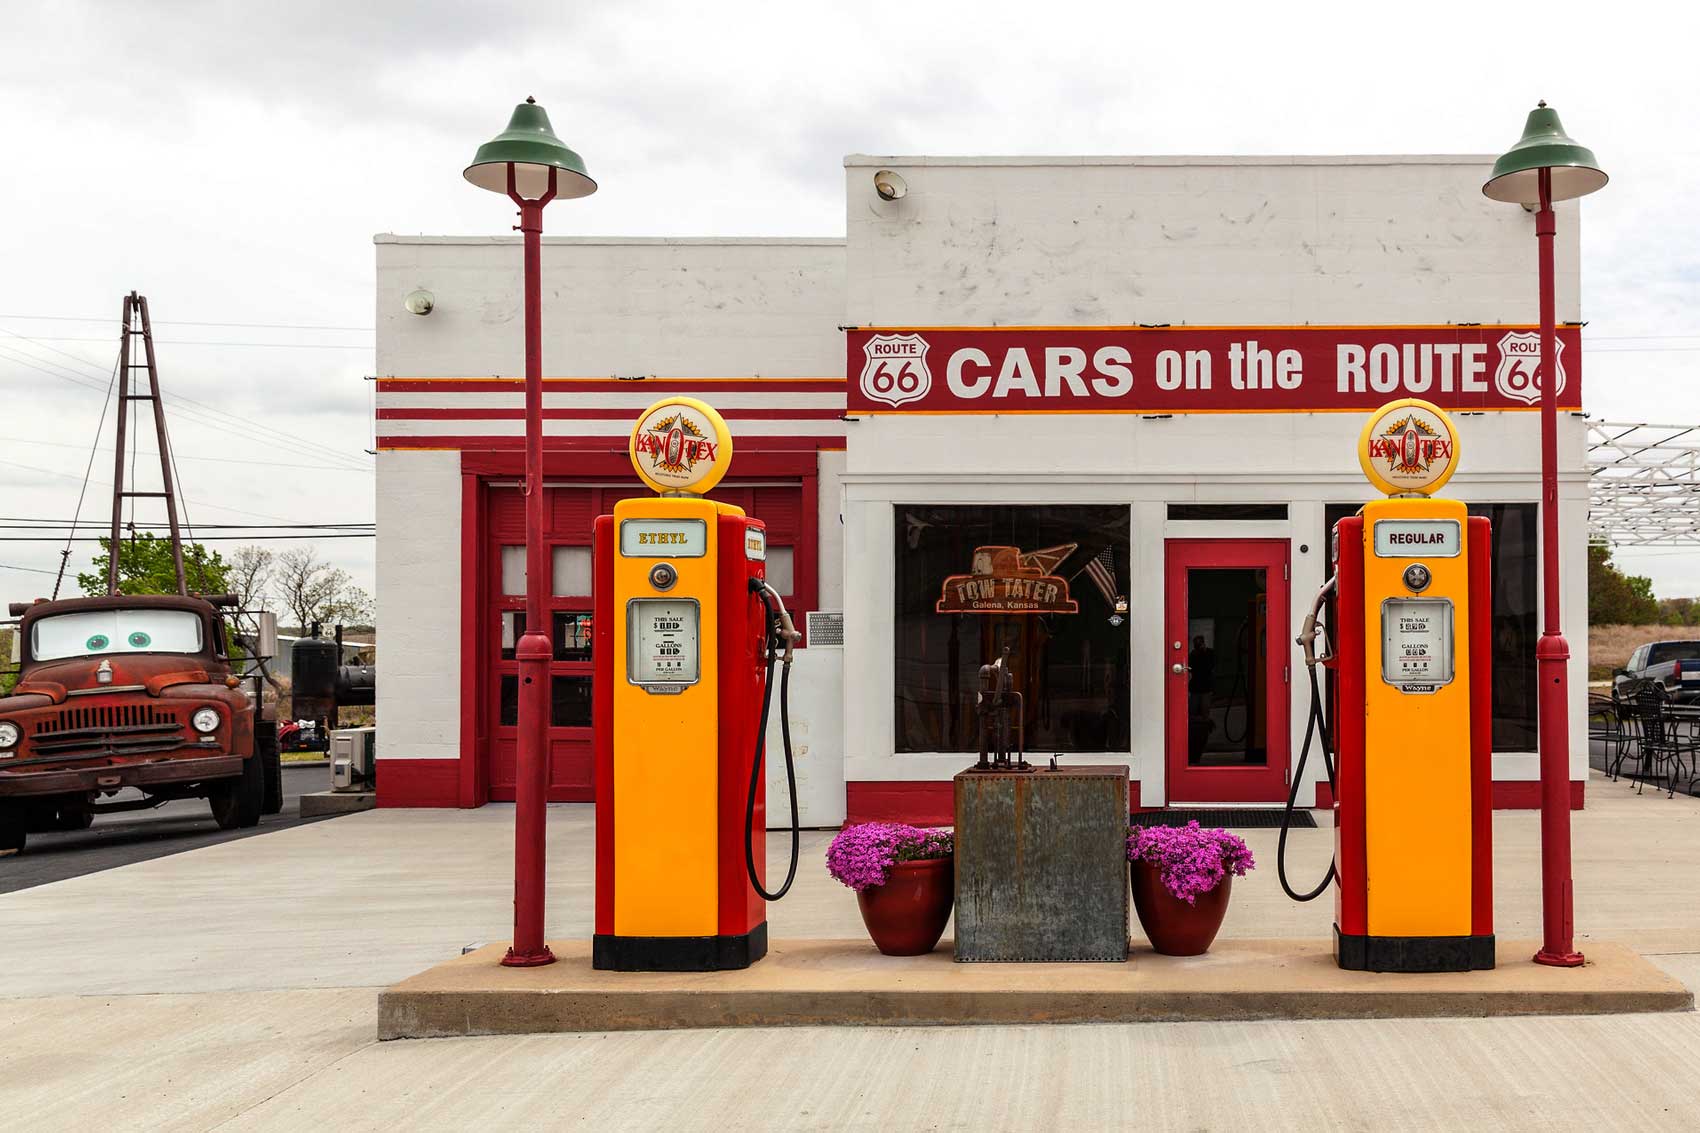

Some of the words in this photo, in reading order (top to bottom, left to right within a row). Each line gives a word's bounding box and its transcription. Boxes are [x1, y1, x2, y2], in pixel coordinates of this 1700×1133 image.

[874, 343, 917, 355] ROUTE
[1510, 343, 1541, 353] ROU
[946, 346, 1134, 399] CARS
[1155, 349, 1212, 391] on
[1228, 340, 1303, 391] the
[1336, 343, 1488, 394] ROUTE
[872, 360, 920, 394] 66
[639, 533, 688, 544] ETHYL
[1389, 533, 1444, 545] REGULAR
[957, 579, 995, 603] TOW
[1002, 577, 1058, 603] TATER
[972, 601, 1004, 609] Galena,
[1007, 601, 1039, 609] Kansas
